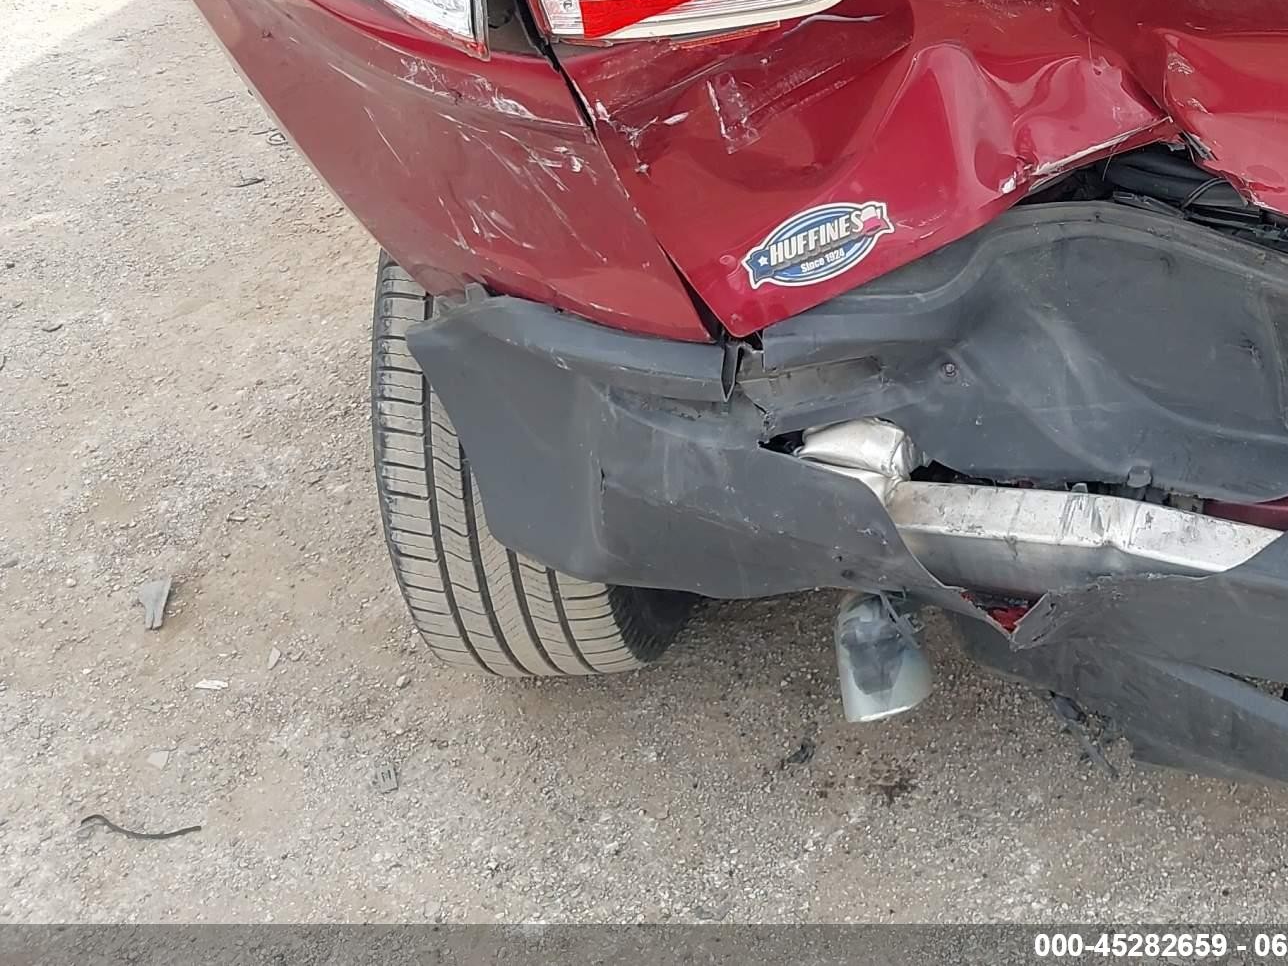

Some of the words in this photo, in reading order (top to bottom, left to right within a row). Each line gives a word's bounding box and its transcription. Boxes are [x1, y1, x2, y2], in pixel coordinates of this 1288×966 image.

[769, 210, 864, 267] HUFFINES
[800, 258, 825, 273] Since
[826, 248, 846, 265] 1924
